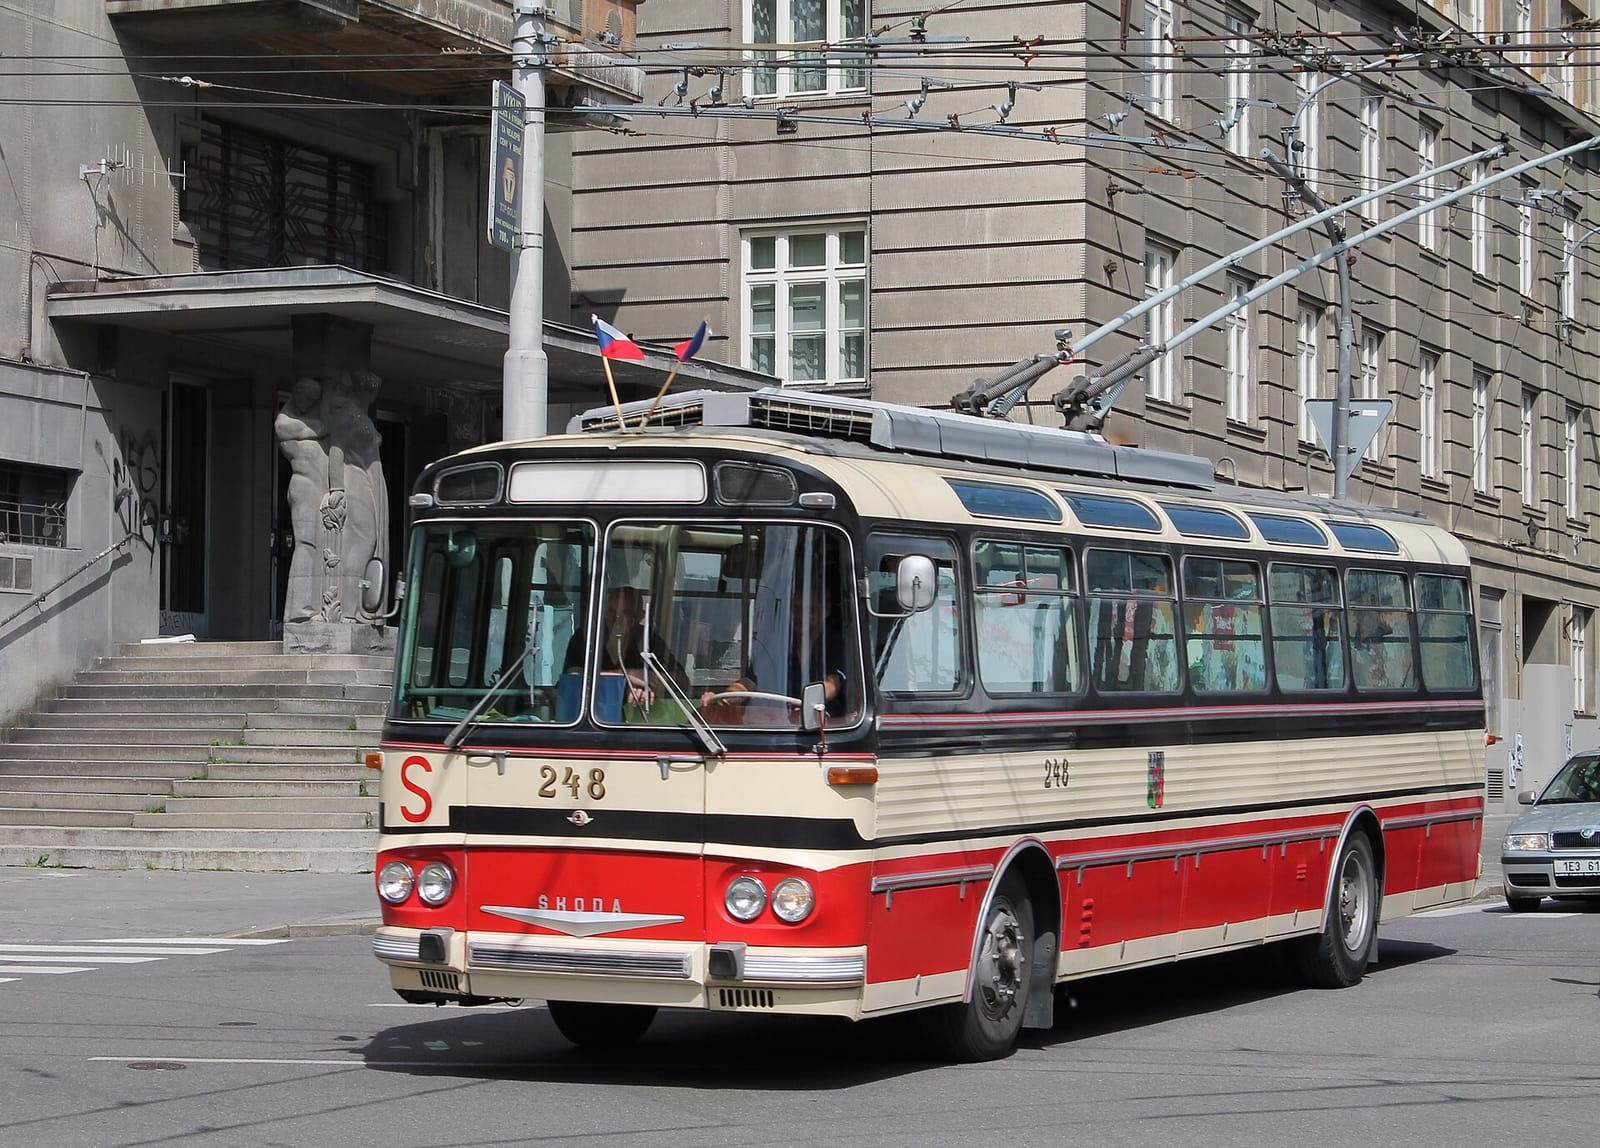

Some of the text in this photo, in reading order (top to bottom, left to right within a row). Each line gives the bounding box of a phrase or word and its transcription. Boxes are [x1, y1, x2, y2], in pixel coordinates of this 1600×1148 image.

[400, 755, 433, 823] S
[538, 764, 606, 800] 248
[1044, 758, 1069, 788] 248
[1563, 861, 1581, 872] 1E3
